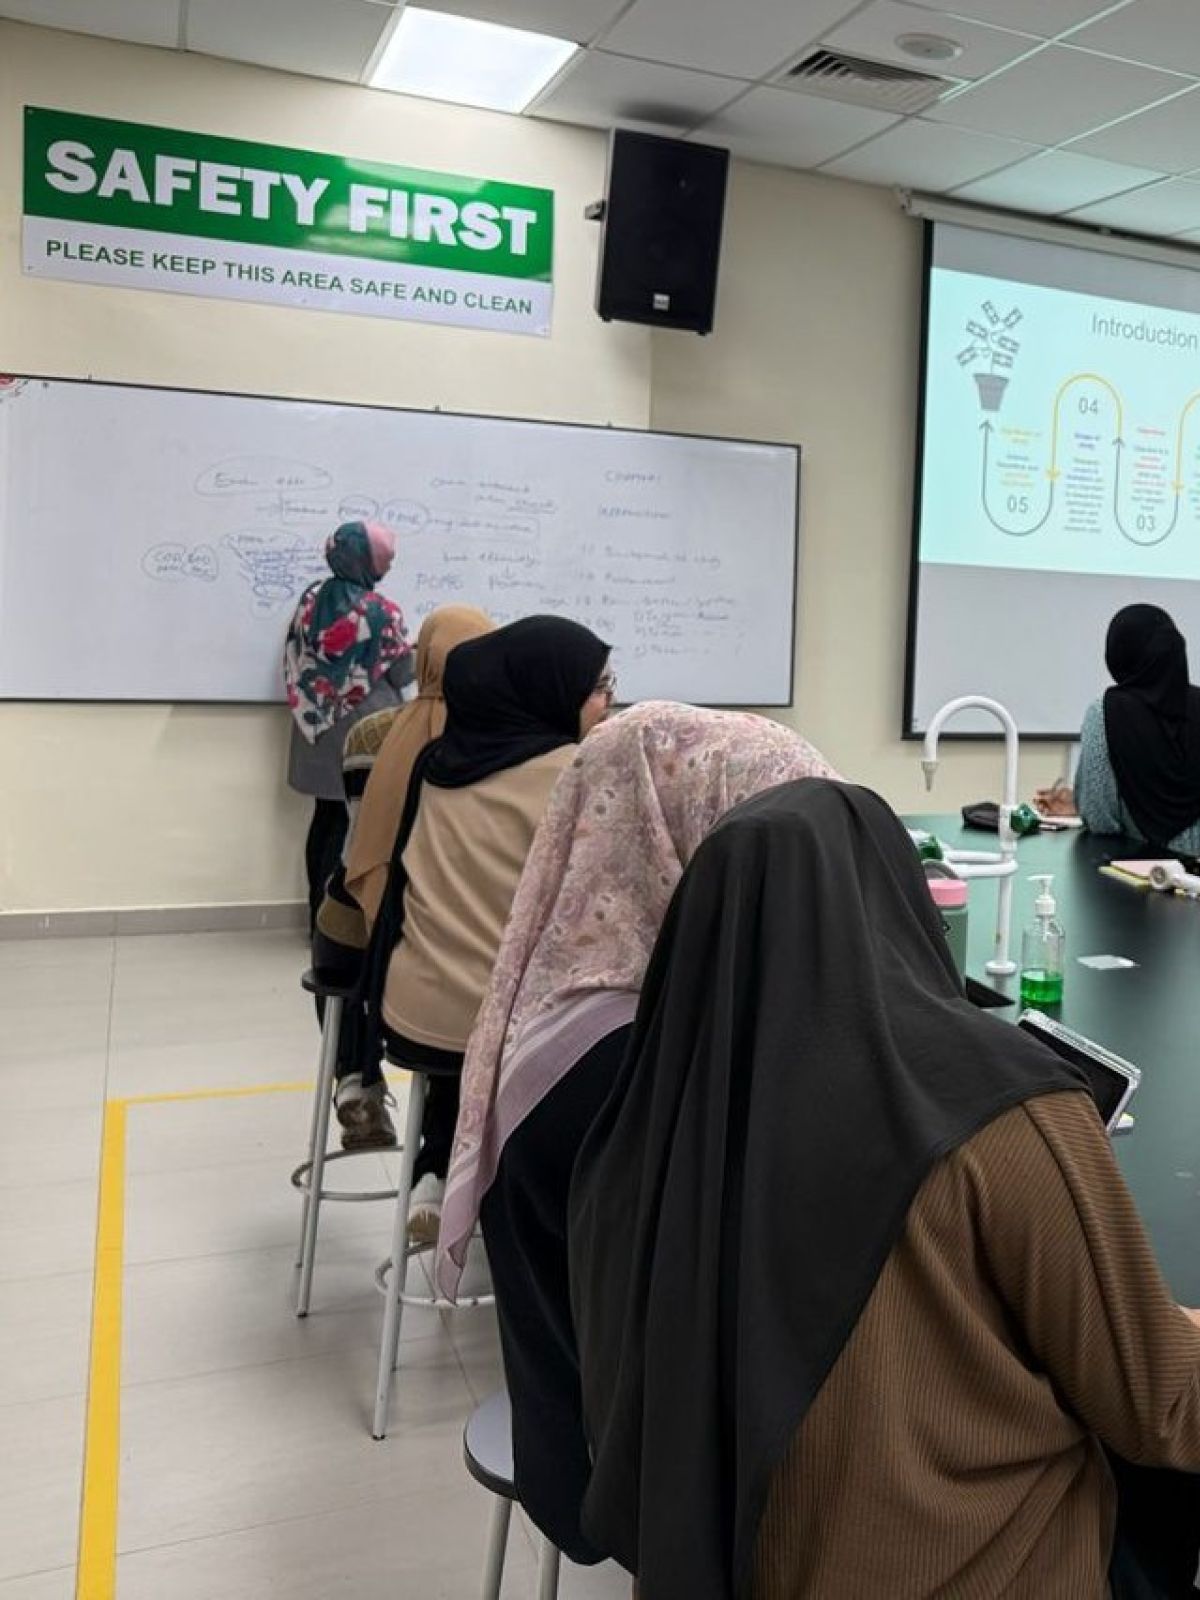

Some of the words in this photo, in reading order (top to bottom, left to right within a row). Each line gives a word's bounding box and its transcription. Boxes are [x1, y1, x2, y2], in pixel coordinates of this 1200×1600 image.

[45, 140, 331, 225] SAFETY
[349, 183, 537, 256] FIRST
[46, 239, 144, 268] PLEASE
[153, 252, 217, 276] KEEP
[224, 262, 275, 284] THIS
[281, 270, 344, 293] AREA
[350, 277, 408, 300] SAFE
[412, 286, 458, 306] AND
[463, 292, 533, 315] CLEAN
[1092, 312, 1199, 351] Introduction
[1078, 397, 1099, 416] 04
[1006, 494, 1029, 514] 05
[1136, 514, 1156, 532] 03
